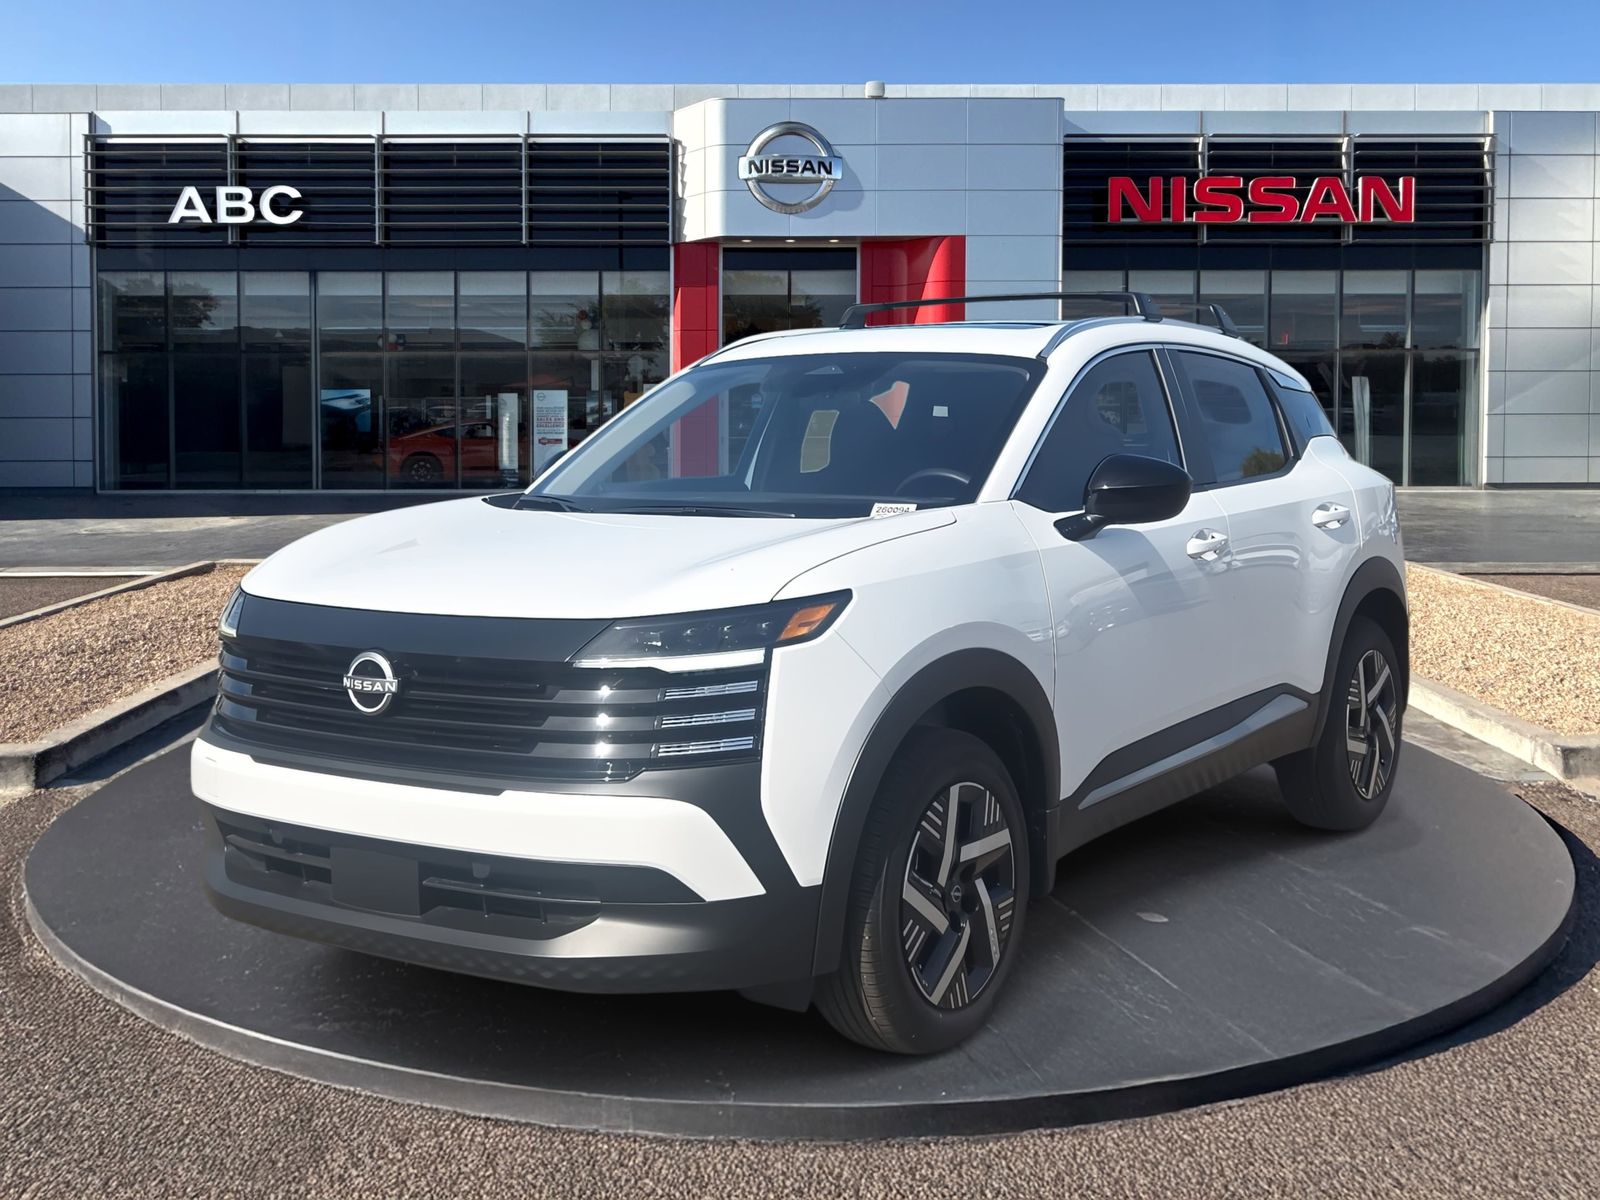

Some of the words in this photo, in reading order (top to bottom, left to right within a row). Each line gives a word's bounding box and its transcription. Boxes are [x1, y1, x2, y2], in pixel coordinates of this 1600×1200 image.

[748, 159, 832, 175] NISSAN
[167, 185, 304, 225] ABC
[1107, 176, 1415, 223] NISSAN
[343, 676, 396, 692] NISSAN
